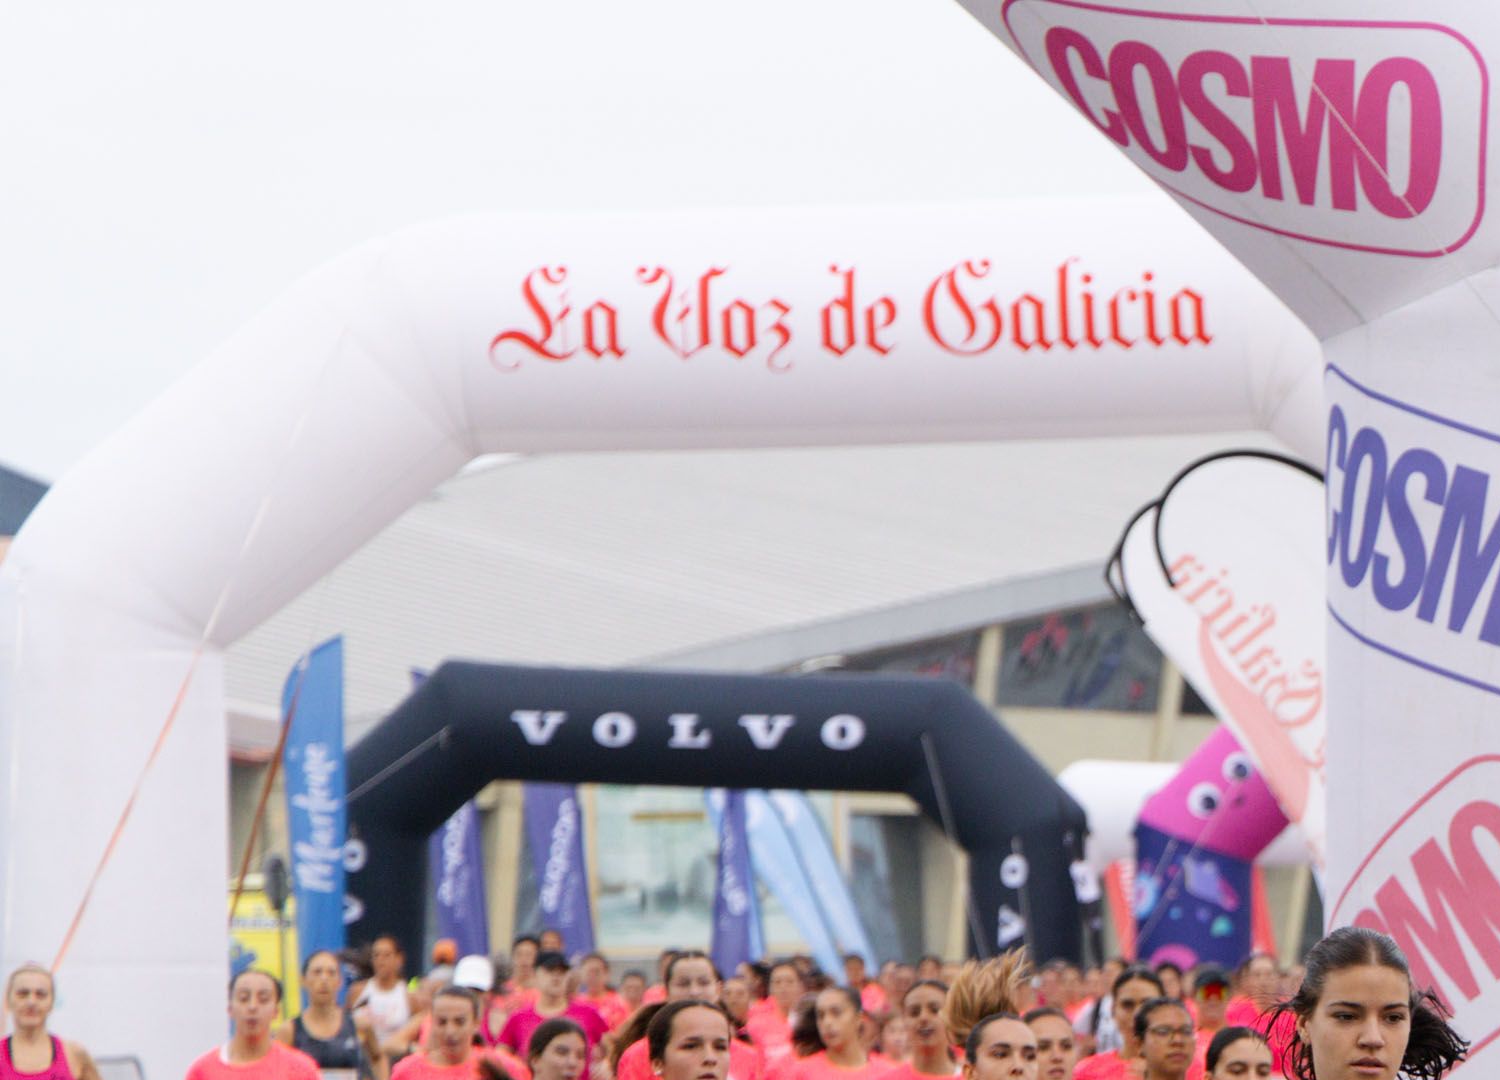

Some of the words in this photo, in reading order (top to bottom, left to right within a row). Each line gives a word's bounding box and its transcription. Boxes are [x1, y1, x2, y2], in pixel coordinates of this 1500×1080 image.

[1044, 26, 1442, 220] COSMO
[489, 265, 628, 372] La
[636, 263, 796, 374] Voz
[819, 263, 898, 356] de
[922, 258, 1214, 356] Galicia
[510, 710, 867, 751] VOLVO
